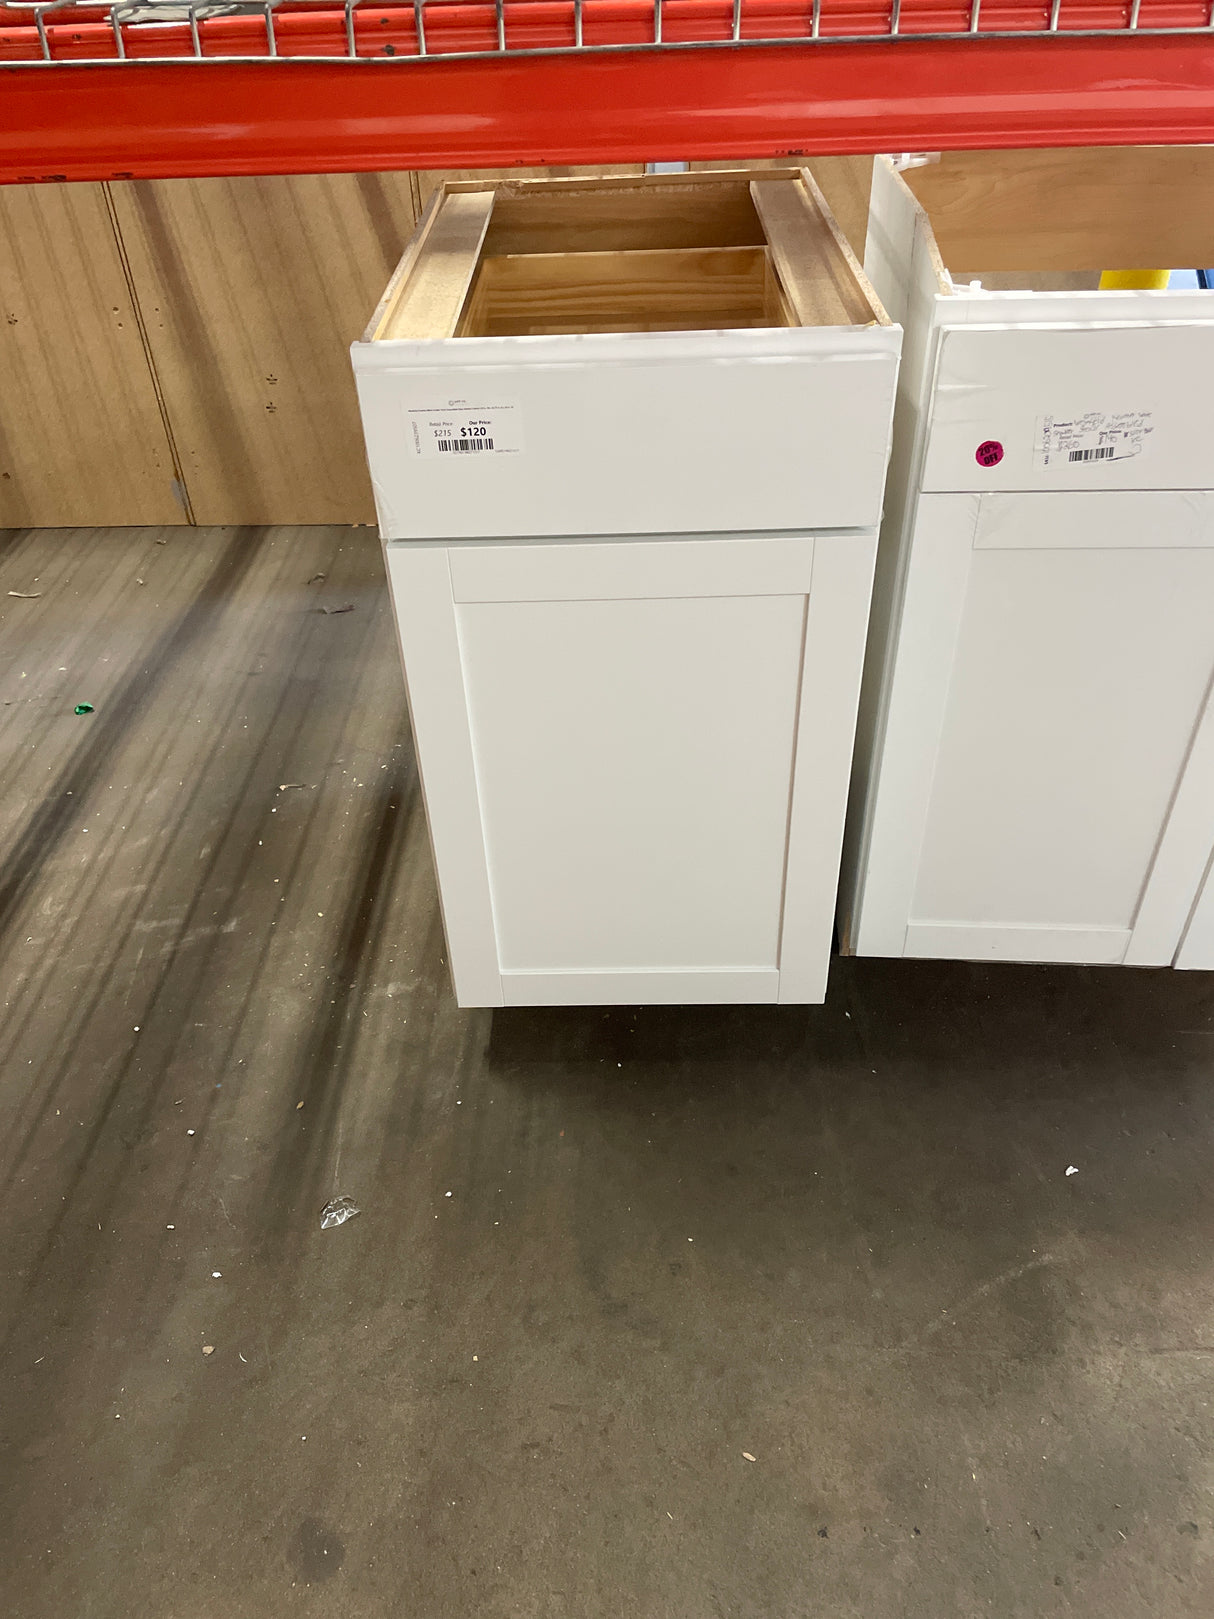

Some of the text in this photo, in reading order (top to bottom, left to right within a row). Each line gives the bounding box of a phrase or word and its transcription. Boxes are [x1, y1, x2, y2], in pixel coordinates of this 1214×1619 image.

[434, 429, 452, 438] $215
[460, 427, 487, 437] $120
[979, 444, 998, 456] 20%
[984, 452, 998, 464] OFF
